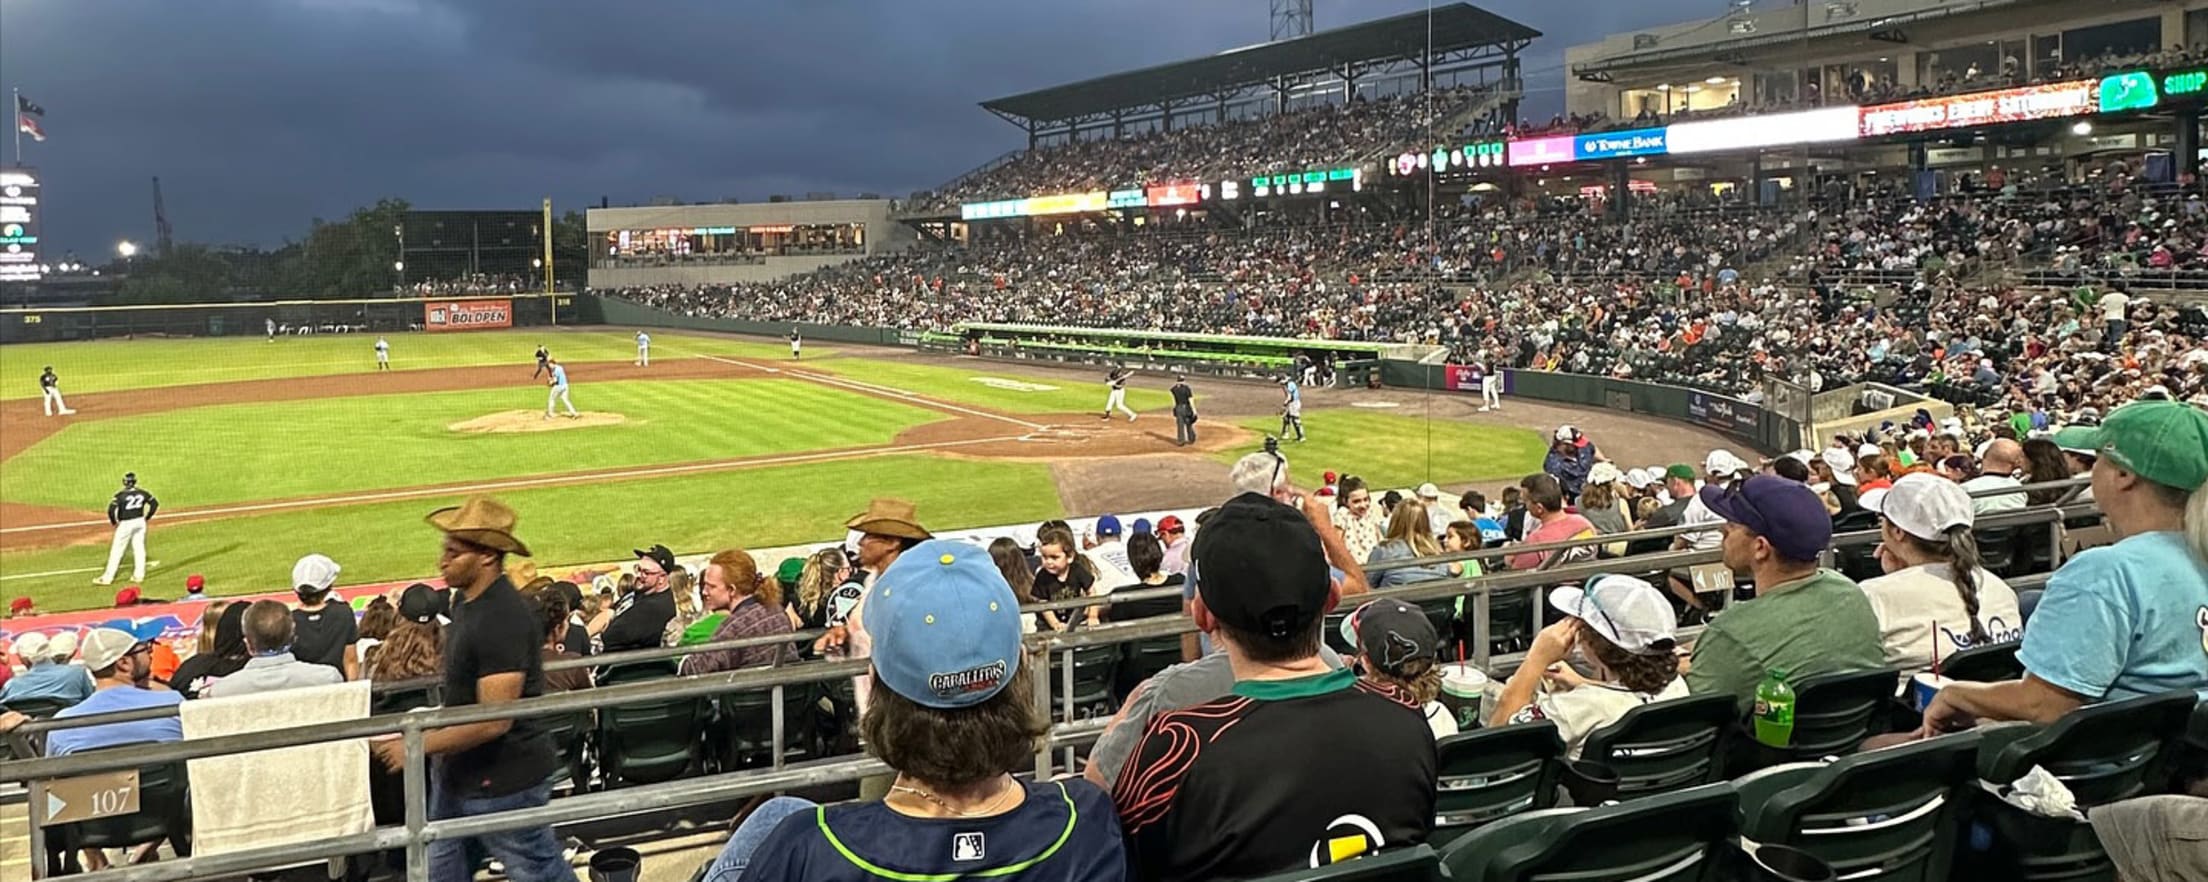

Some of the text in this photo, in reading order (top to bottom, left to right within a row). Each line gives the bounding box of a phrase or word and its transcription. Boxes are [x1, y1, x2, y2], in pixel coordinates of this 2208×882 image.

[2164, 72, 2207, 94] SHOP
[125, 494, 144, 510] 22
[91, 786, 132, 815] 107
